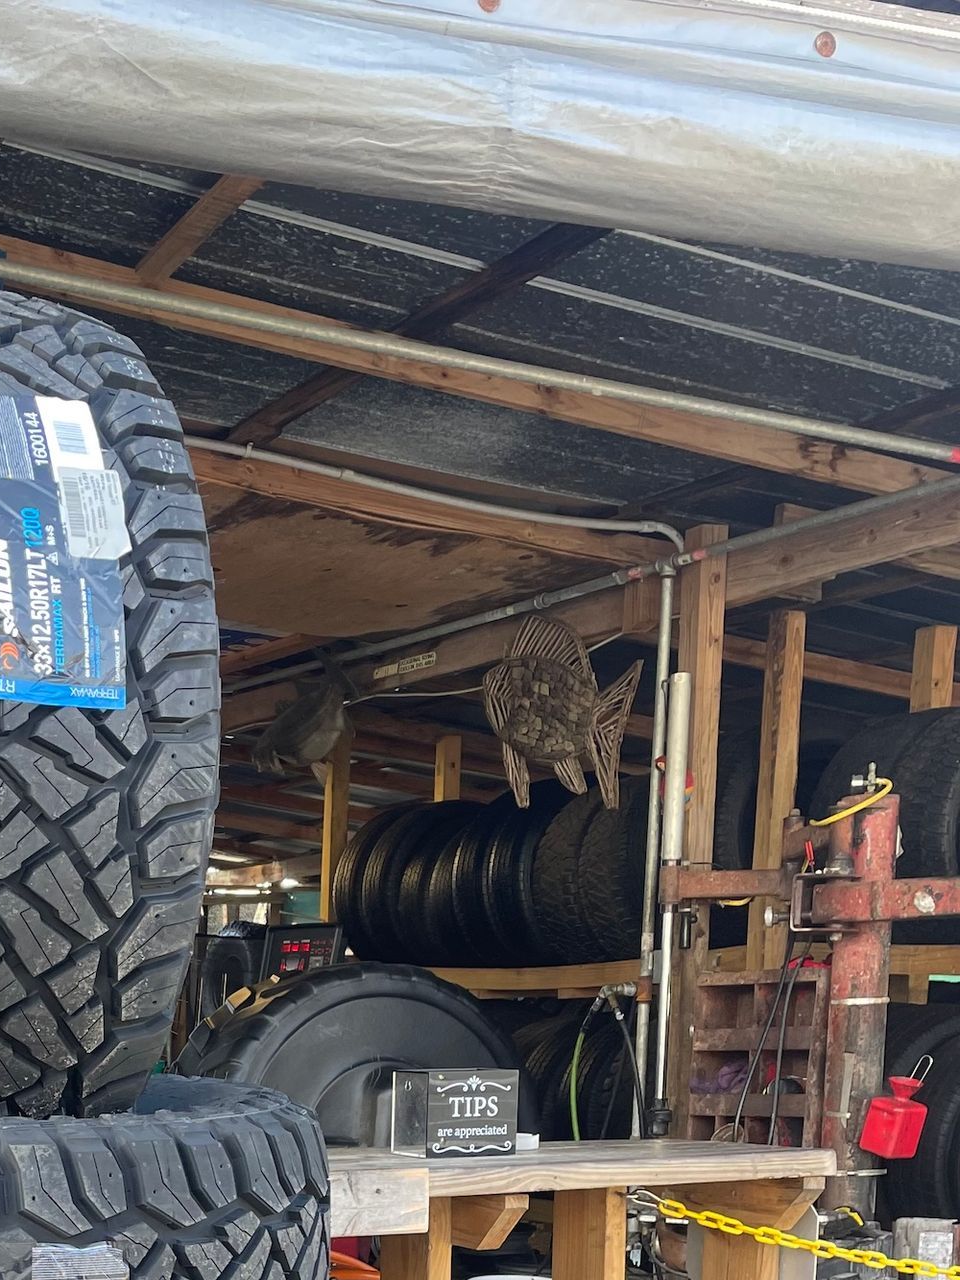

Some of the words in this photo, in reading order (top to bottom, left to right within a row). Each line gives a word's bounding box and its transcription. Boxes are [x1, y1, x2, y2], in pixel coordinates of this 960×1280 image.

[24, 410, 50, 467] 1600144
[20, 506, 45, 548] 120Q
[44, 524, 57, 546] M+S
[50, 575, 62, 596] RT
[25, 547, 54, 676] 33x12.50R17LT
[52, 598, 66, 675] TERRAMAX
[69, 686, 120, 700] TERRAMAX
[449, 1096, 498, 1117] TIPS
[437, 1128, 452, 1136] are
[454, 1124, 507, 1139] appreciated
